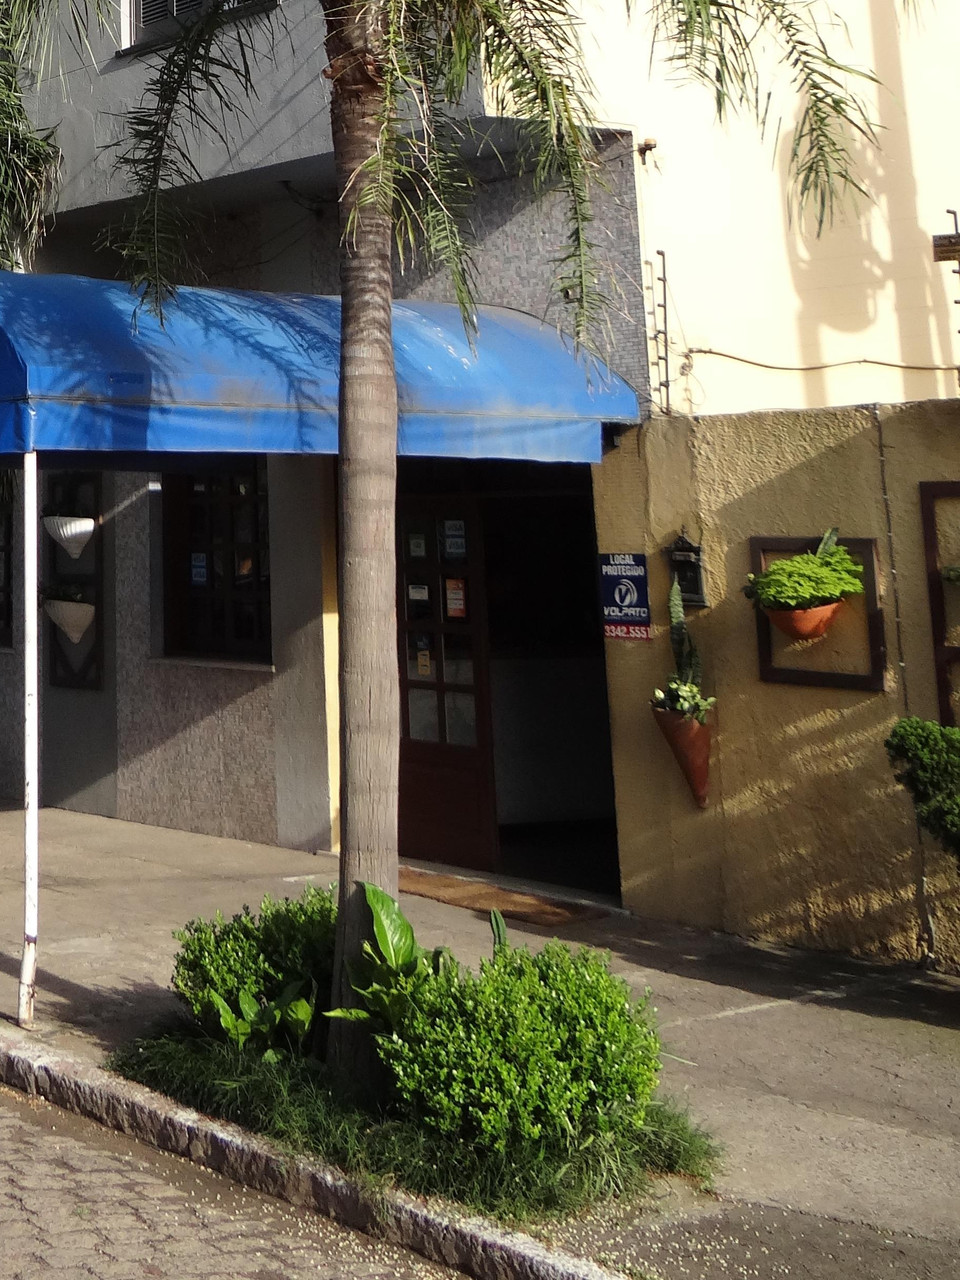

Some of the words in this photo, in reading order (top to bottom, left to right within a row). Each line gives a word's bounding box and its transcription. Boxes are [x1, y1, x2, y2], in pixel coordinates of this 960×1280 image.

[610, 554, 635, 565] LOCAL
[602, 565, 645, 576] PROTEGIDO
[603, 606, 648, 617] VOLPATO
